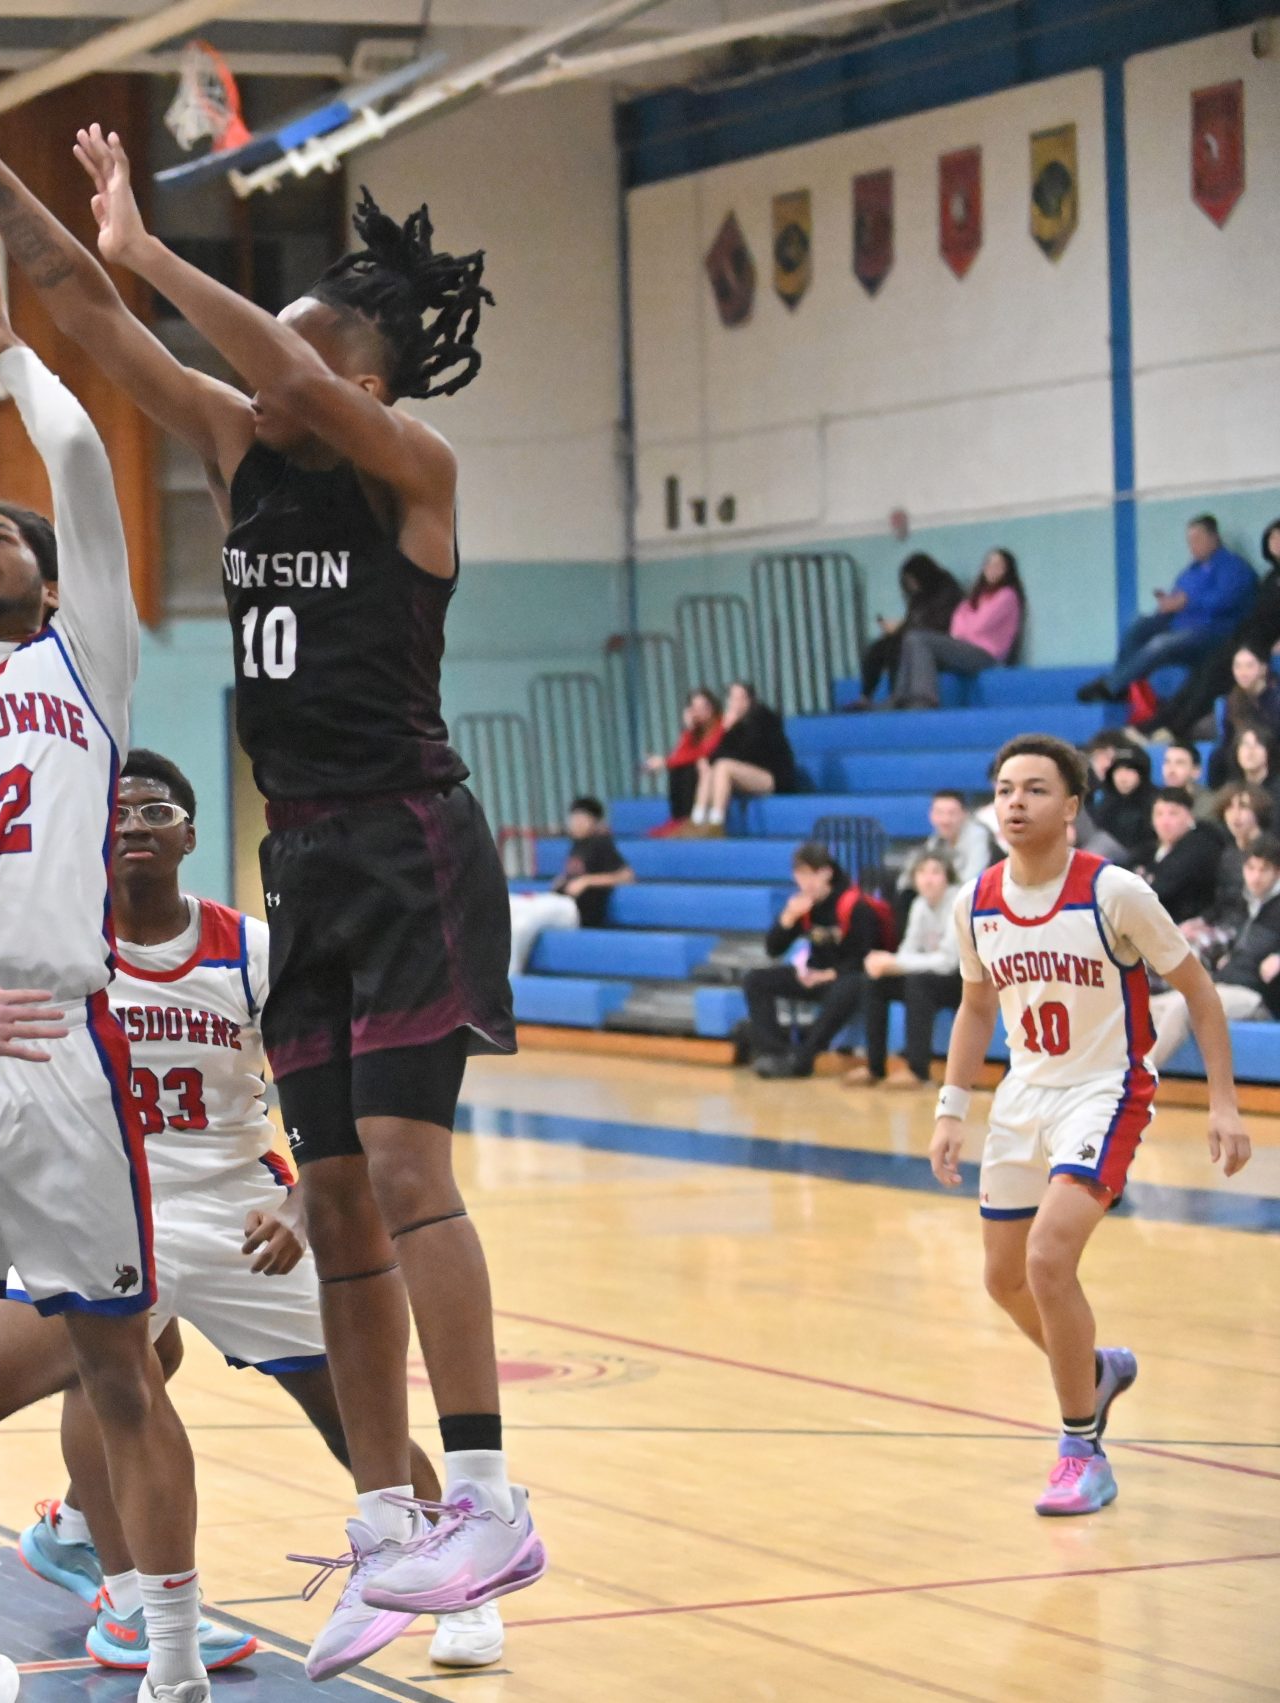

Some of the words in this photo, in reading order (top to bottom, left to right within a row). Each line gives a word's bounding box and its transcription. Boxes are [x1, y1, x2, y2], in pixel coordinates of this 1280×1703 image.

[241, 606, 297, 679] 10
[991, 951, 1105, 992] ANSDOWNE
[1020, 1001, 1071, 1057] 10
